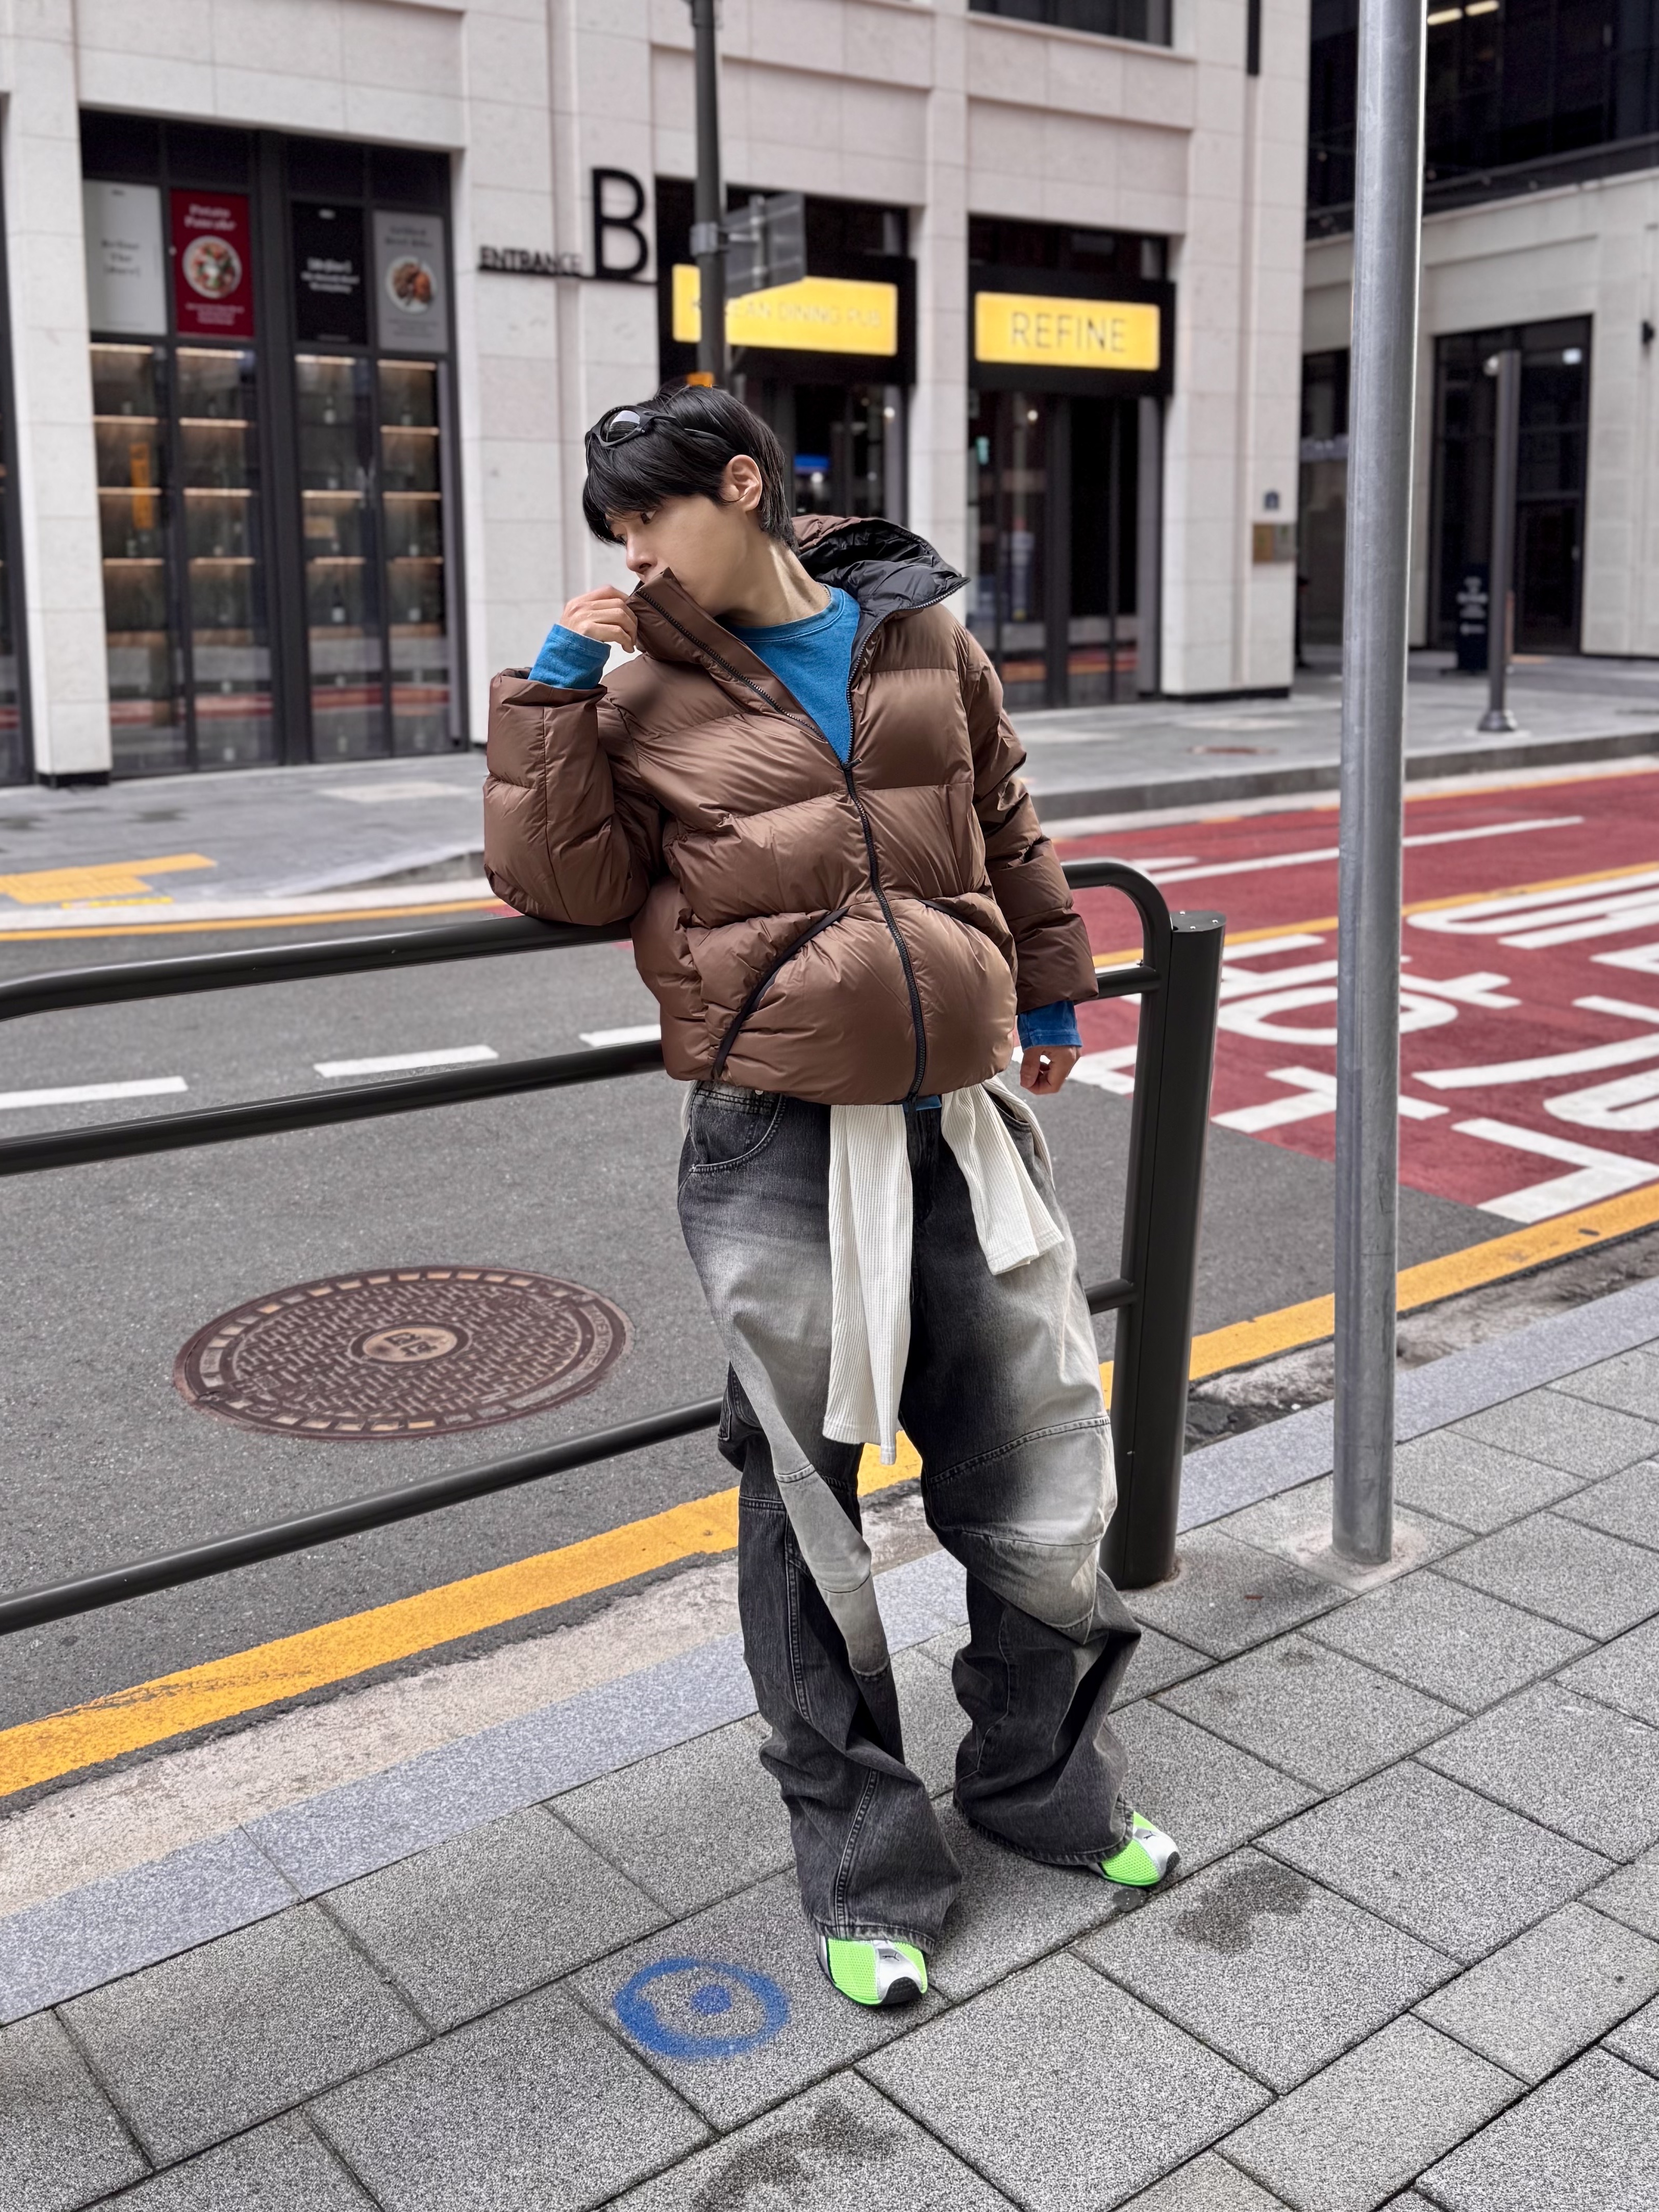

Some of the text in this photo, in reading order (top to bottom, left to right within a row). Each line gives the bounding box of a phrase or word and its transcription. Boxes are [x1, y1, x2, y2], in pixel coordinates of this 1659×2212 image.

[480, 167, 648, 280] ENTRANCE B
[778, 300, 842, 327] DINING
[846, 305, 883, 330] PUB
[1011, 310, 1128, 353] REFINE
